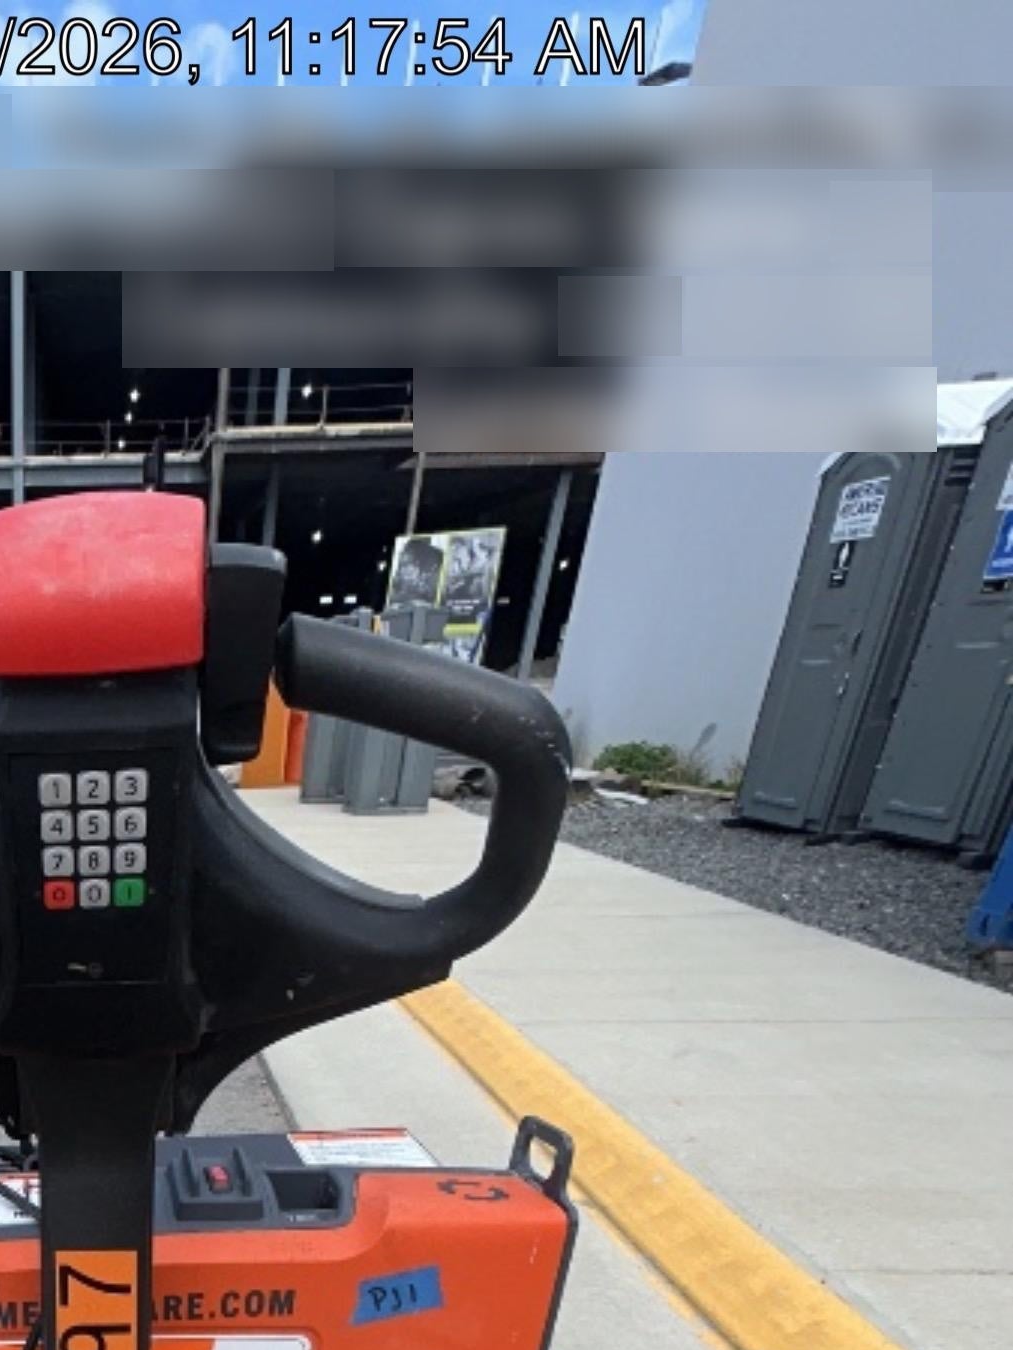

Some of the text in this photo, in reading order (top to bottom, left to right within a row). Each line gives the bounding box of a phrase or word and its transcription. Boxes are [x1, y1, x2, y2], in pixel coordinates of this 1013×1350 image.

[51, 776, 138, 799] 1 2 3
[49, 815, 137, 835] 4 5 6
[52, 851, 136, 870] 7 8 9
